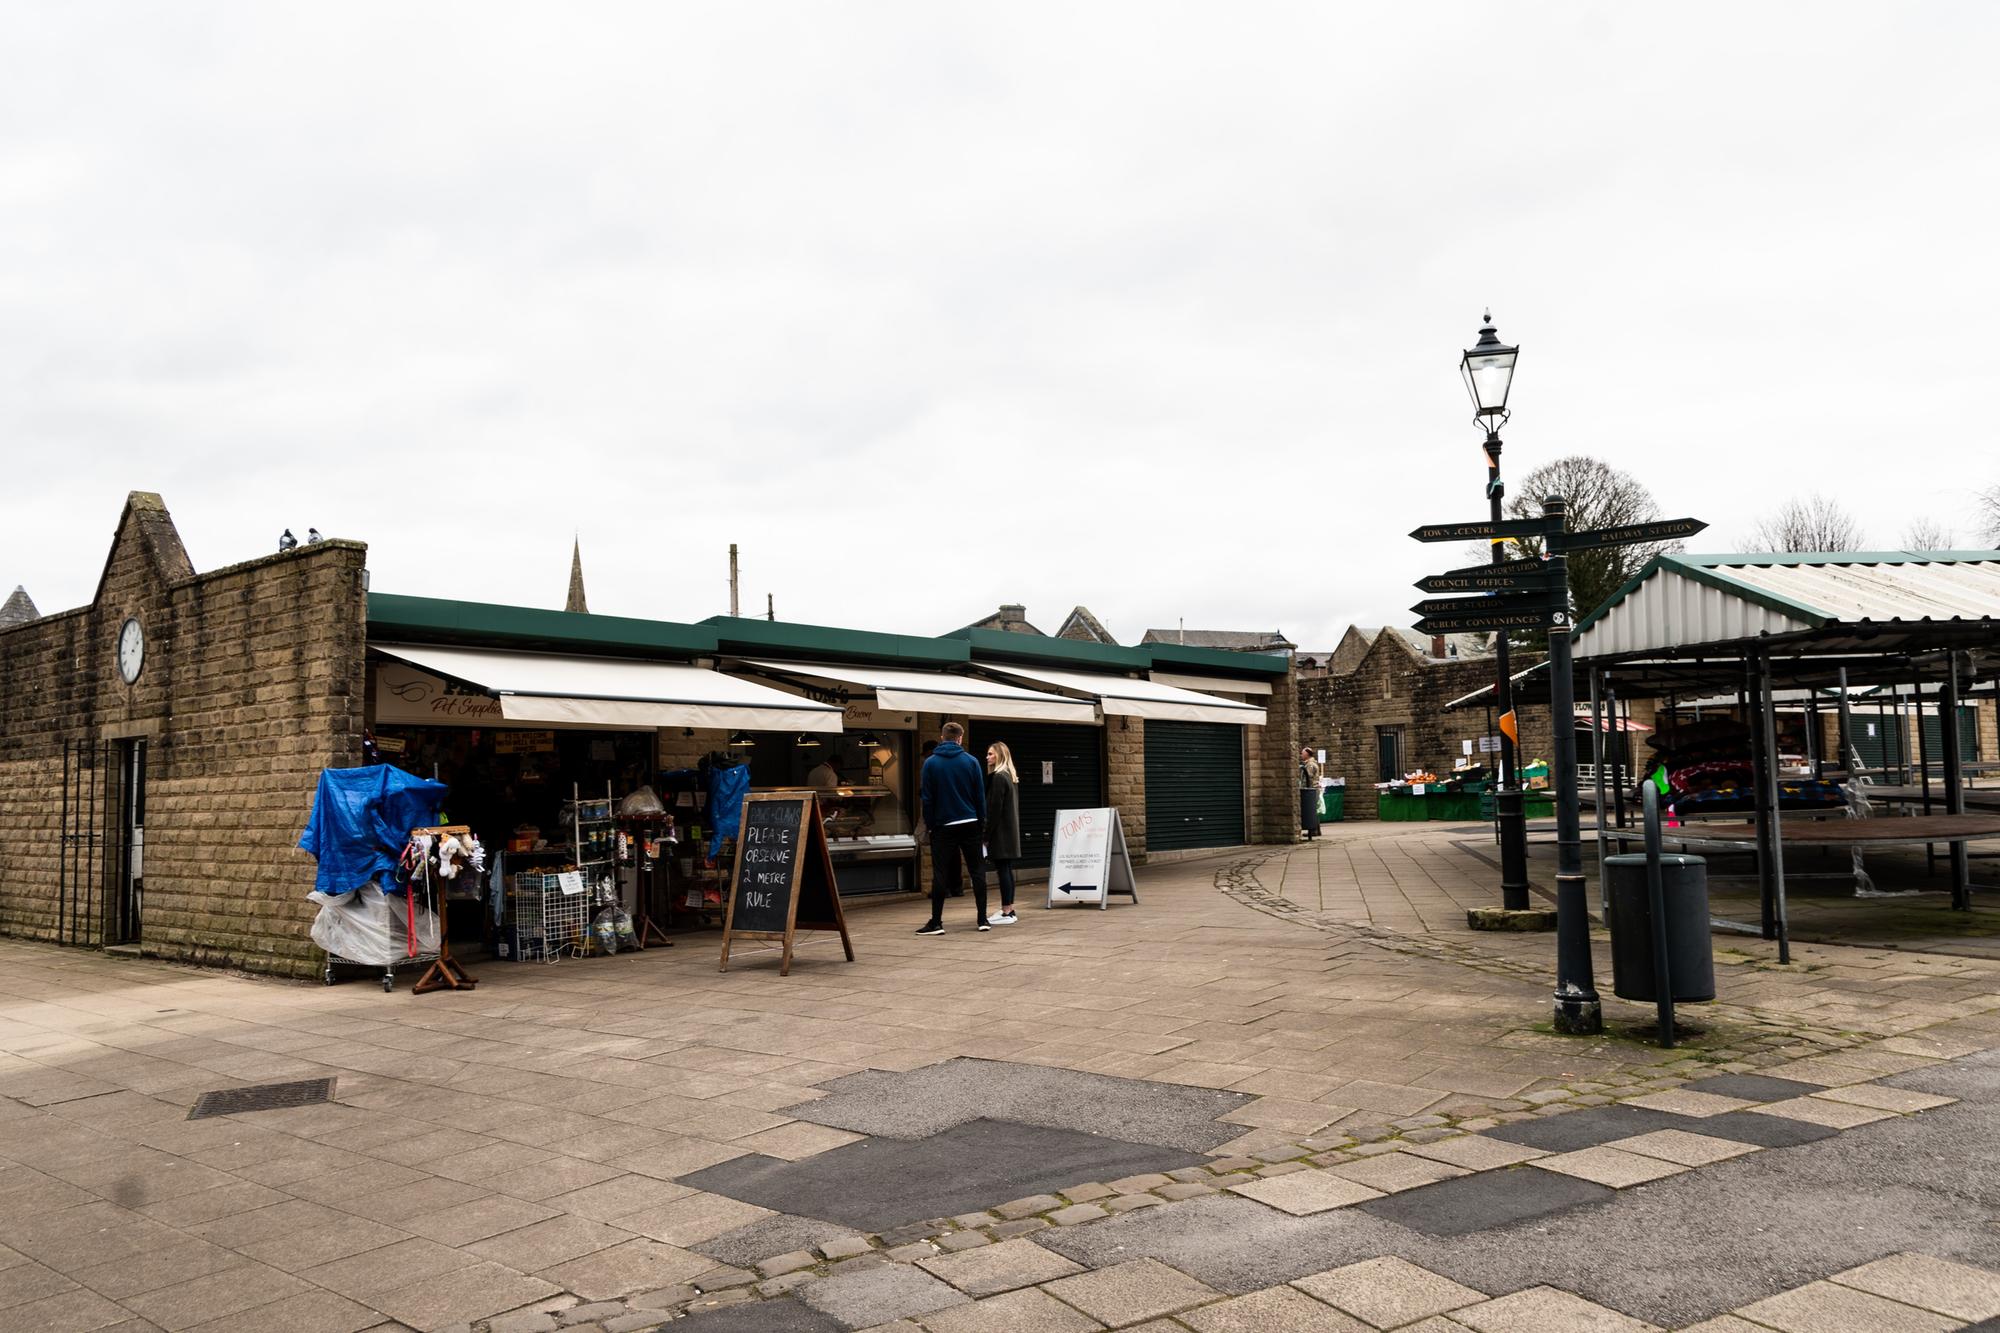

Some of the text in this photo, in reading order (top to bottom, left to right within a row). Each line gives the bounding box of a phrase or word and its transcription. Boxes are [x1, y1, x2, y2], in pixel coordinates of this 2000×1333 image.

[1423, 526, 1496, 538] TOWN CENTRE
[1601, 522, 1693, 541] RAILWAY STATION
[1428, 577, 1515, 588] COUNCIL OFFICES
[1424, 599, 1504, 612] POLICE STATION
[1426, 615, 1541, 629] PUBLIC CONVENIENCES
[430, 697, 504, 718] Pet Supplie
[1574, 702, 1606, 712] FLOWS
[747, 826, 789, 844] PLEASE
[745, 848, 790, 864] OBSERVE
[743, 868, 786, 885] 2 METRE
[746, 890, 773, 909] RULE
